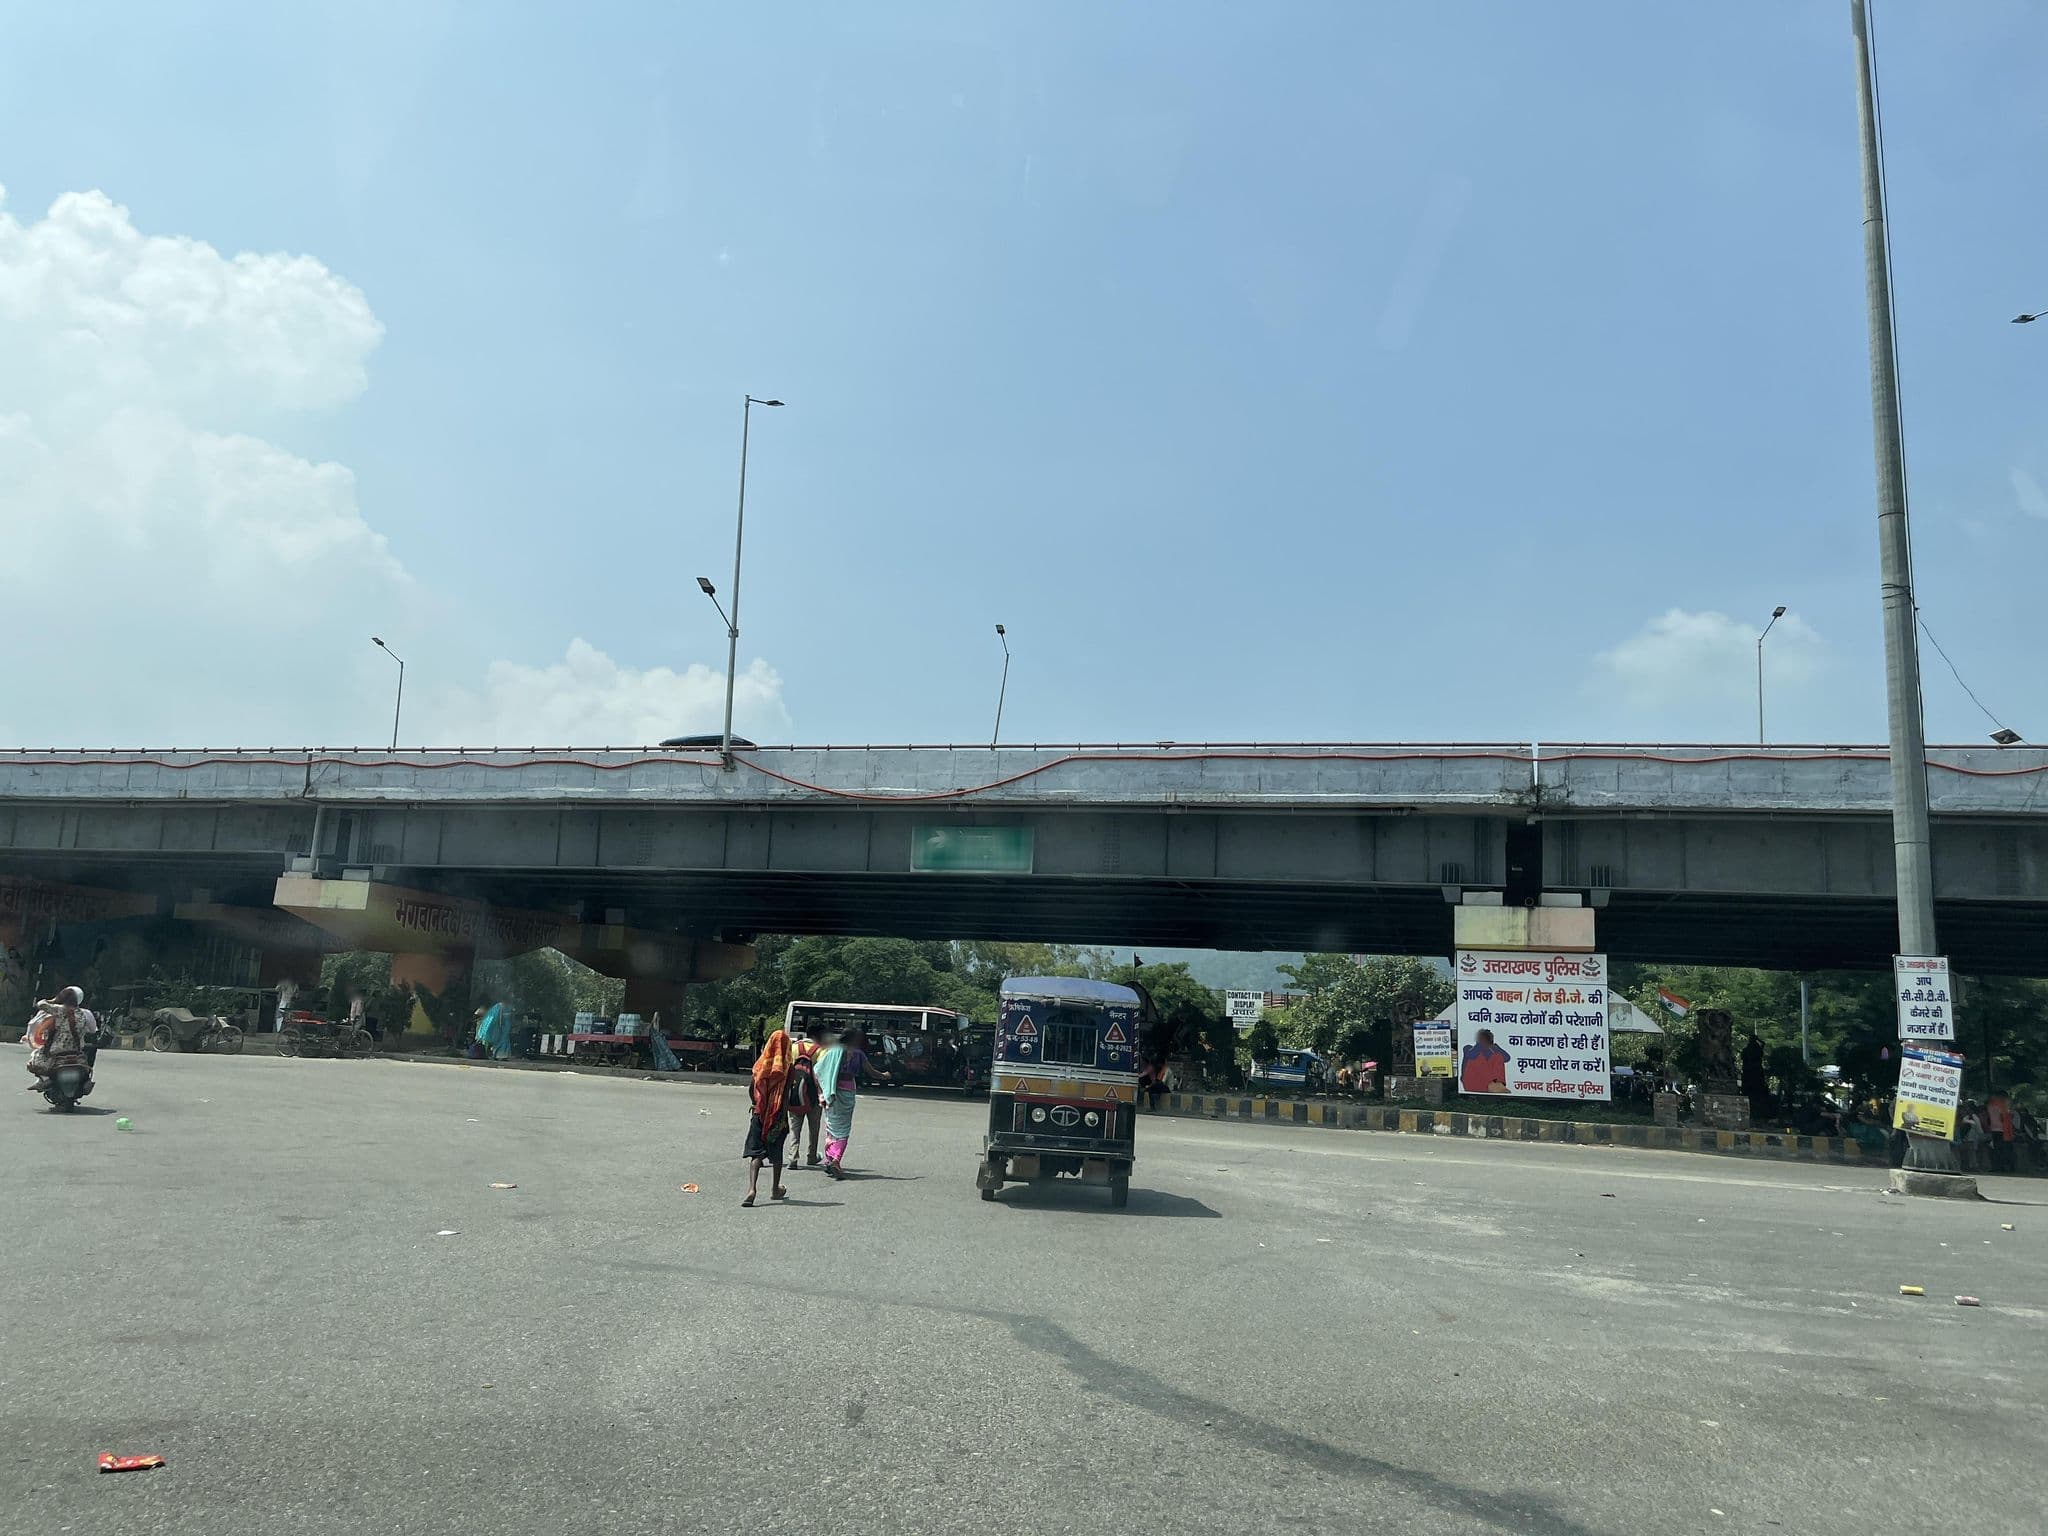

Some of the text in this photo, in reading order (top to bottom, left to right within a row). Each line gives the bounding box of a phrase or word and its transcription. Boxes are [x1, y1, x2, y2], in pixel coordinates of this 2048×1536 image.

[1482, 956, 1580, 982] उत्तराखण्ड पुलिस
[1916, 976, 1932, 986] आप
[1462, 986, 1493, 1001] आपके
[1496, 990, 1523, 1003] वाहन
[1533, 988, 1552, 1004] तेज
[1588, 989, 1603, 1005] की
[1234, 1000, 1255, 1008] DISPLAY
[1910, 1005, 1943, 1018] कैमरे की
[1468, 1008, 1603, 1027] ध्वनि अन्य लोगों की परेशानी
[1906, 1024, 1927, 1035] नजर
[1508, 1035, 1523, 1047] का
[1526, 1035, 1554, 1047] कारण
[1557, 1034, 1568, 1050] हो
[1571, 1034, 1588, 1050] रही
[1517, 1057, 1547, 1073] कृपया
[1550, 1056, 1569, 1070] शोर
[1571, 1059, 1580, 1071] न
[1514, 1079, 1604, 1098] जनपद हरिद्वार पुलिस
